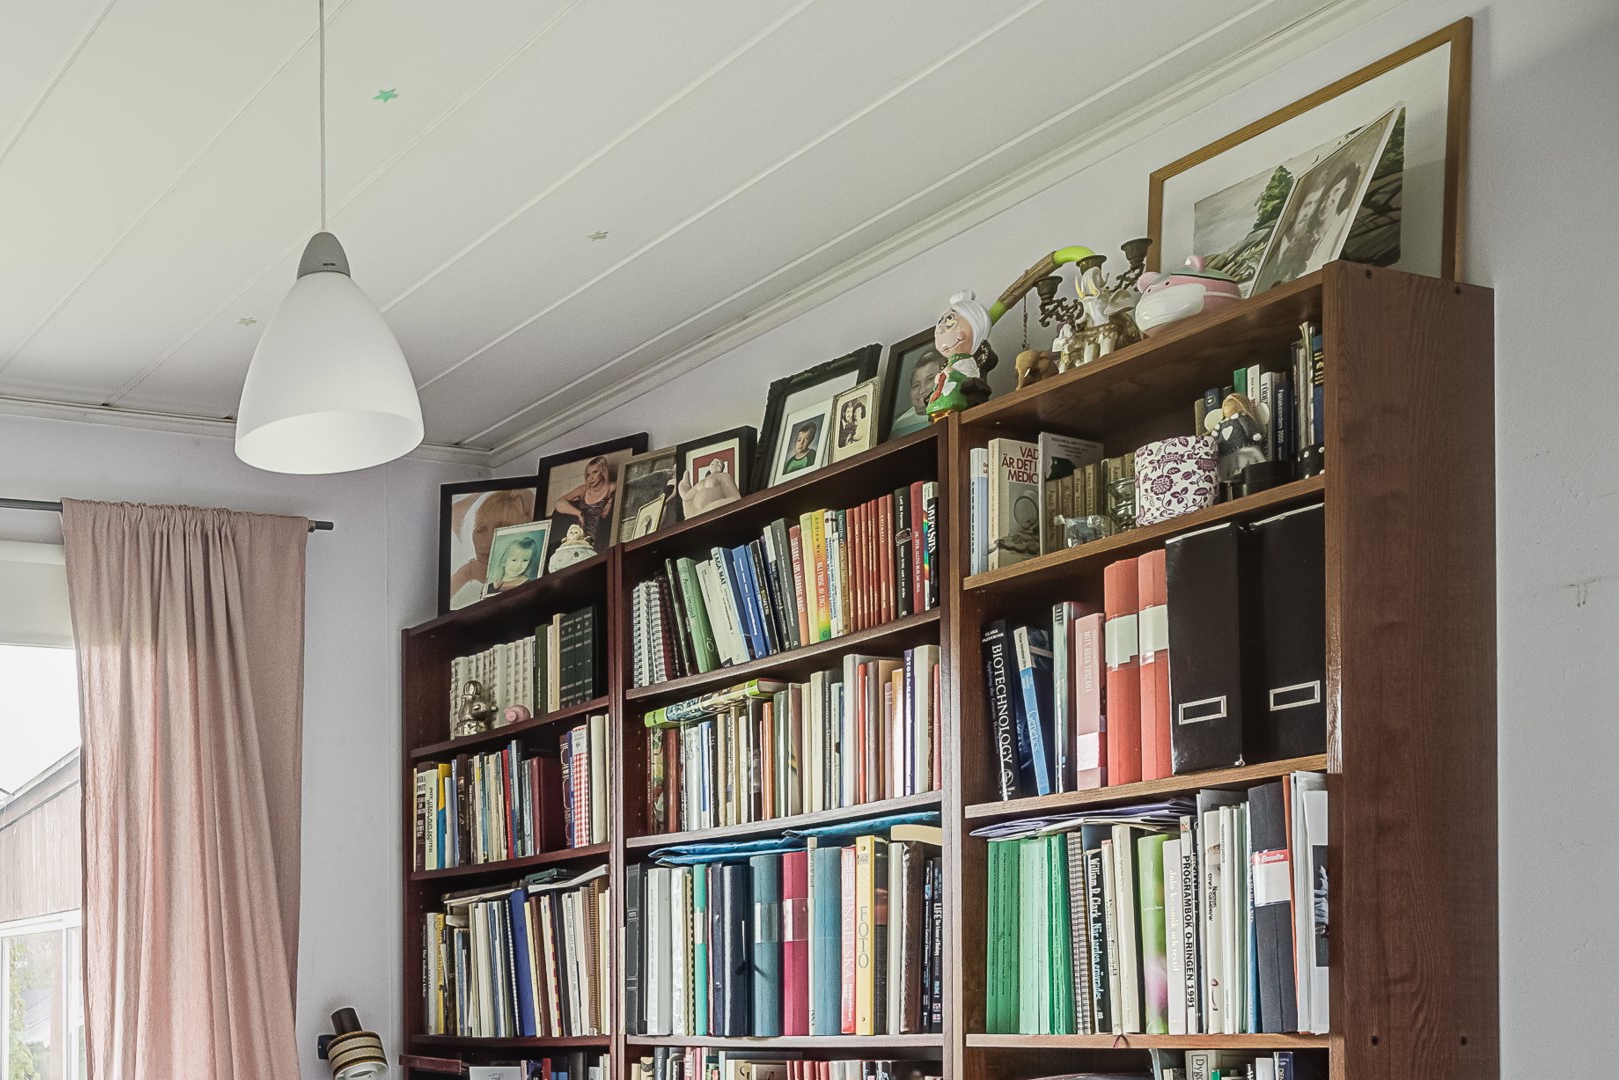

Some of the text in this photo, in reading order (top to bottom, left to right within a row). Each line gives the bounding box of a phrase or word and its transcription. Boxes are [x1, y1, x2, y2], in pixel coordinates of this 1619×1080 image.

[1001, 453, 1014, 468] ÄR
[1016, 460, 1033, 472] DET
[1020, 446, 1039, 460] VAD
[713, 552, 725, 585] LAGA MAT
[761, 590, 769, 615] BIOMETRI
[992, 644, 1012, 764] BIOTECHNOLOGY
[1027, 710, 1041, 751] Genetics
[1260, 853, 1285, 862] Esselte
[1089, 857, 1100, 887] William
[934, 903, 942, 919] LIFE
[1092, 897, 1101, 918] Clark
[843, 895, 853, 978] ENGELSKA
[858, 906, 869, 969] FOTO
[1183, 855, 1194, 1009] PROGRAMBOK O-RINGEN 1991
[1171, 949, 1179, 971] textil
